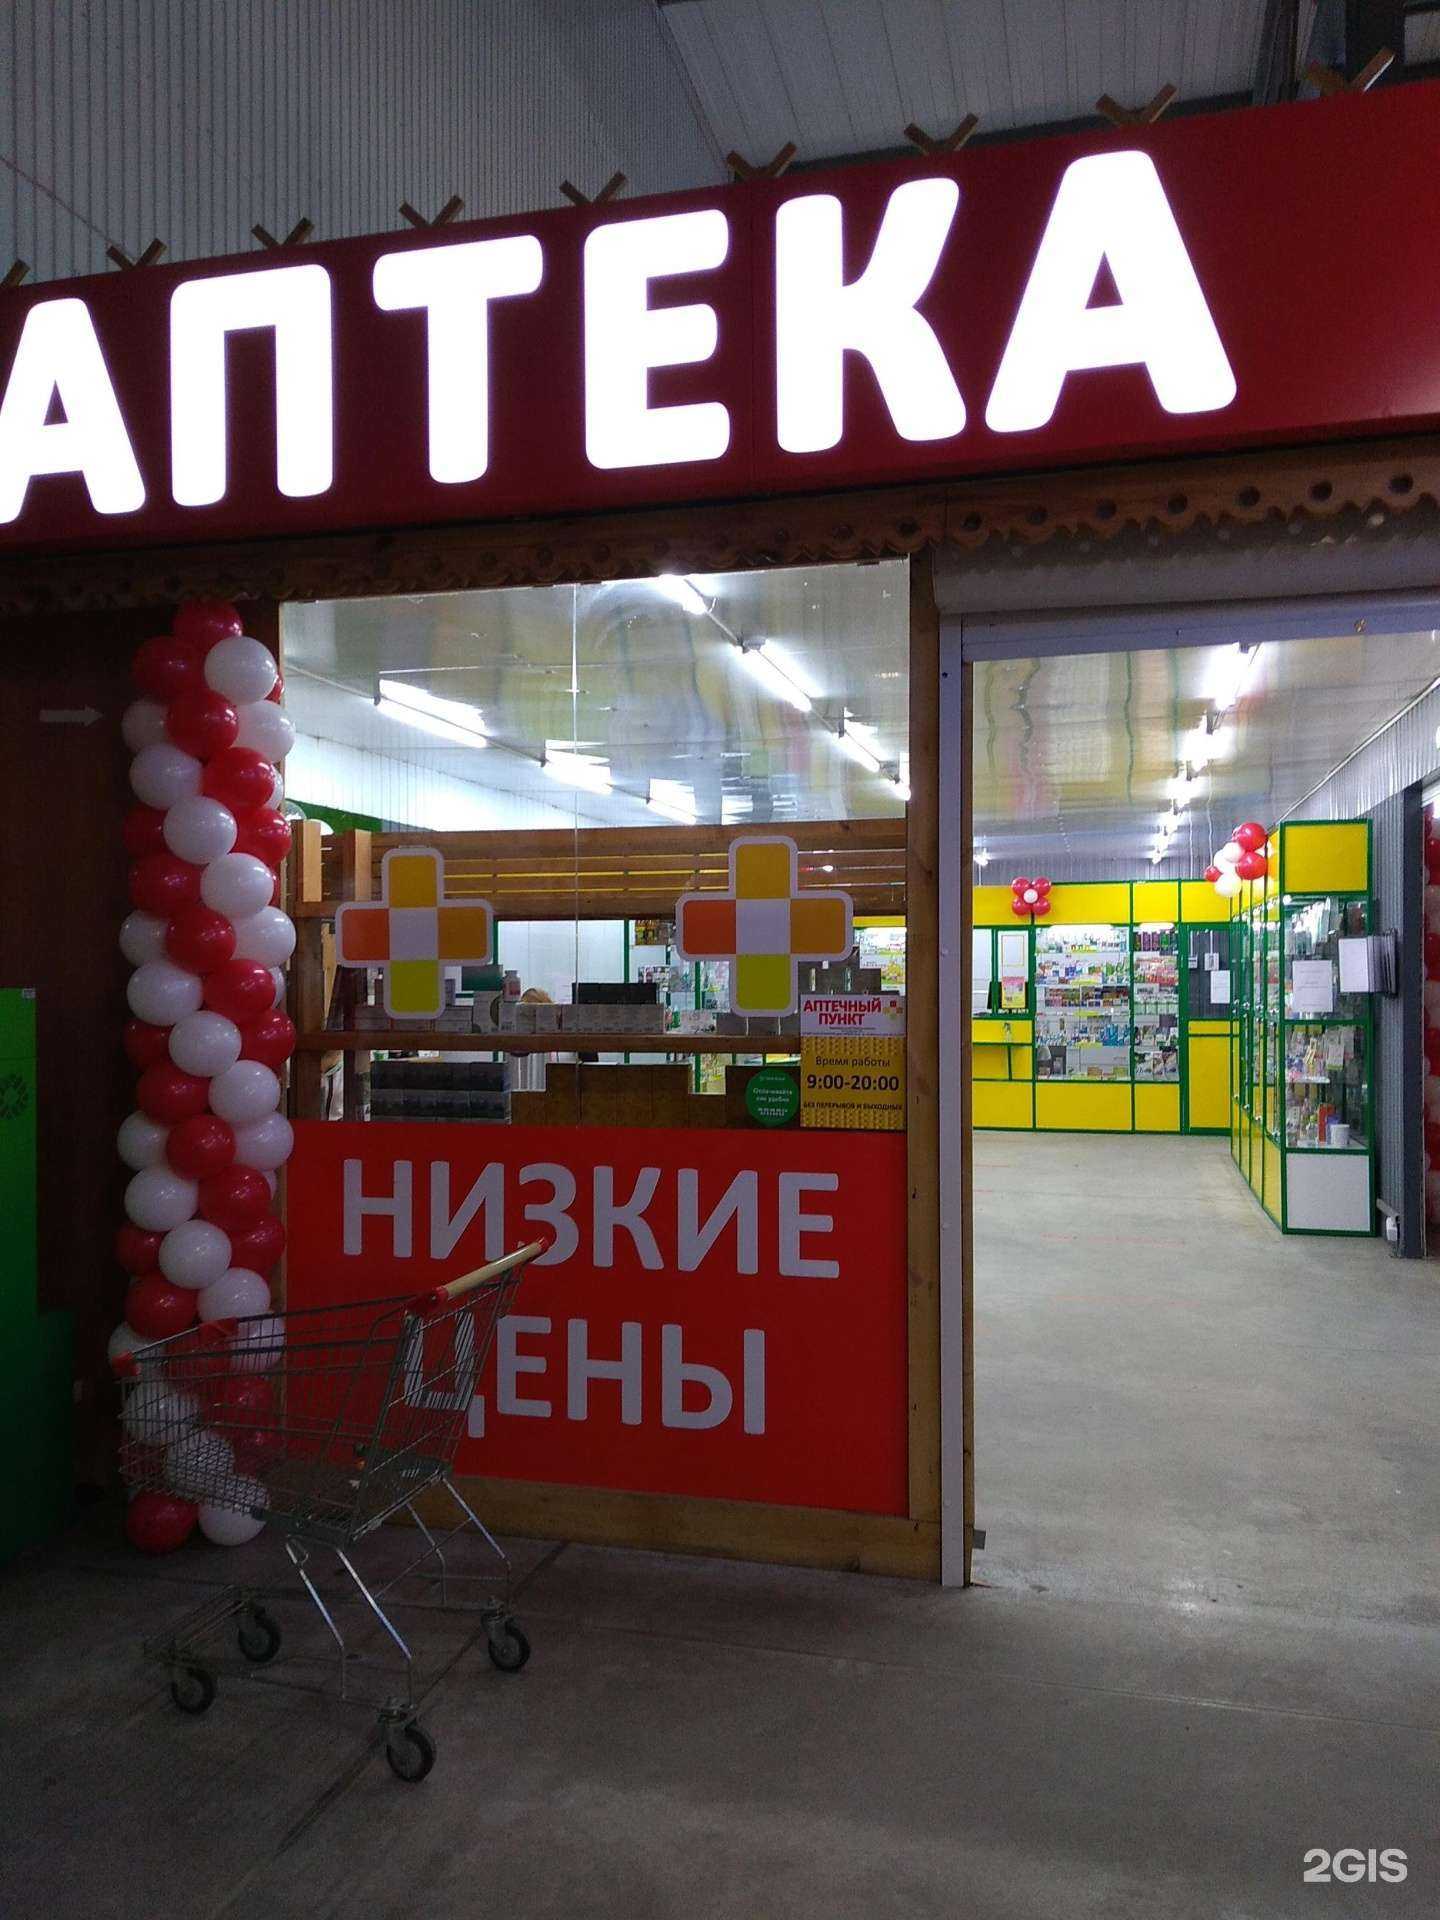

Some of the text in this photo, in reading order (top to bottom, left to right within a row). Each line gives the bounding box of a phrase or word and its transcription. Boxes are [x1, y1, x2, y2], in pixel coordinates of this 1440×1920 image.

[0, 149, 1238, 526] АПТЕКА
[803, 997, 882, 1013] АПТЕЧНЫЙ
[818, 1013, 865, 1026] ПУНКТ
[815, 1056, 890, 1067] Время работы
[806, 1074, 900, 1091] 9:00-20:00
[342, 1158, 840, 1279] НИЗКИЕ
[403, 1310, 766, 1438] ЦЕНЫ
